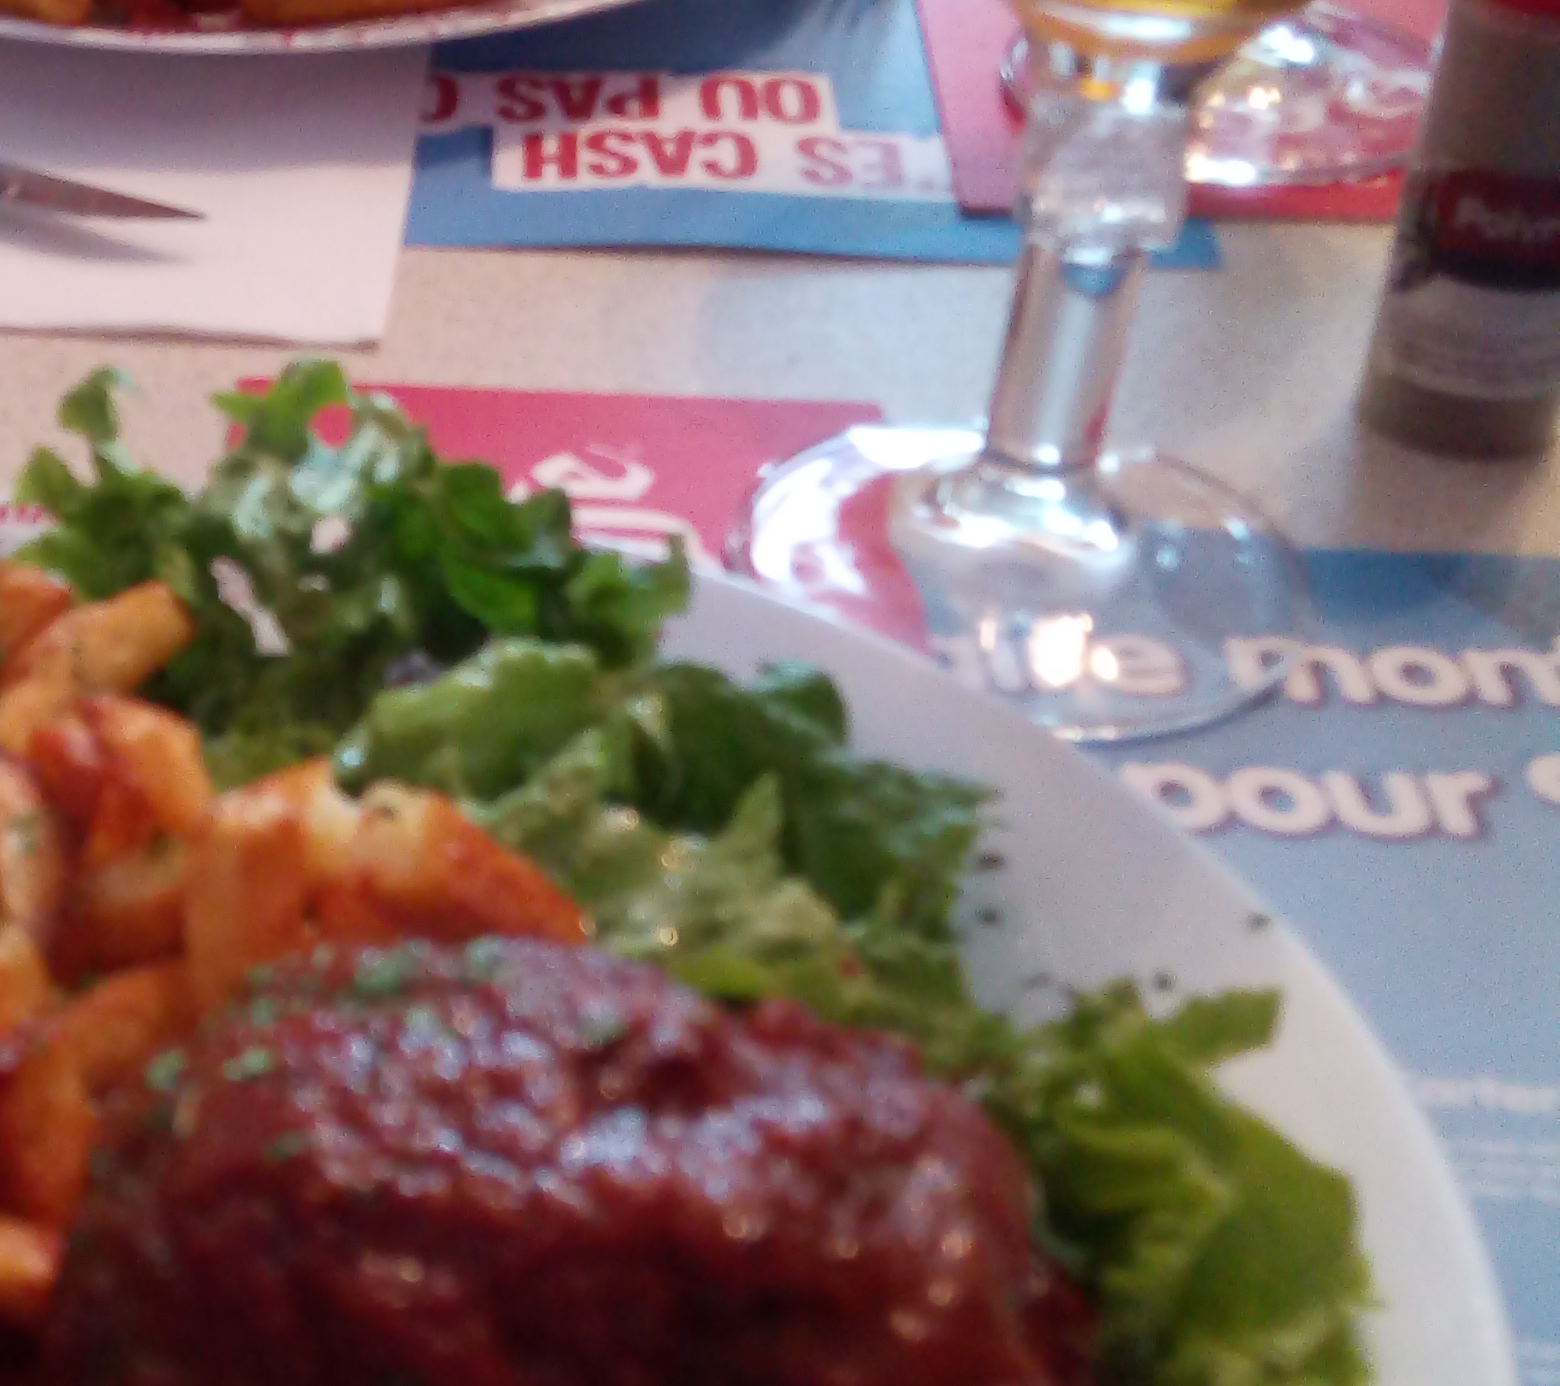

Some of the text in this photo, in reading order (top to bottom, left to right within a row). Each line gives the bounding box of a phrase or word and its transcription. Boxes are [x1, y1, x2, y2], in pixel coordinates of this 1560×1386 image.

[494, 74, 662, 125] PAS
[698, 74, 822, 125] OU
[521, 130, 759, 182] CASH
